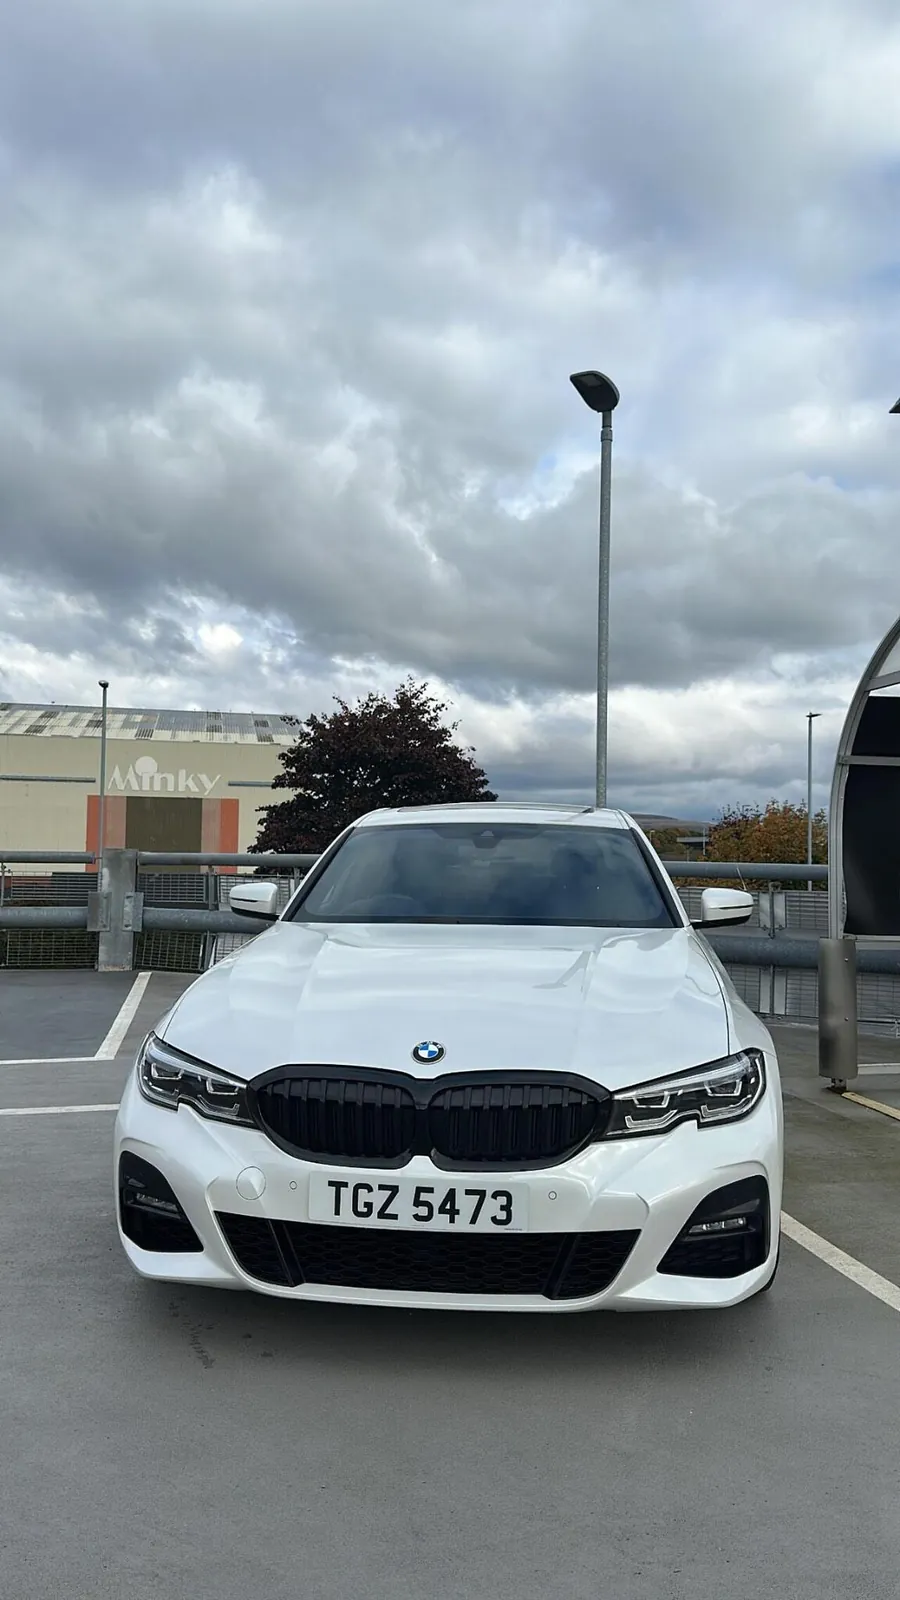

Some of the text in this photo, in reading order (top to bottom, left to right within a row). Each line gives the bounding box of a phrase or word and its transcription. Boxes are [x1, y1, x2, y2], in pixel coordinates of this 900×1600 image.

[107, 756, 222, 796] Minky
[327, 1180, 513, 1226] TGZ 5473
